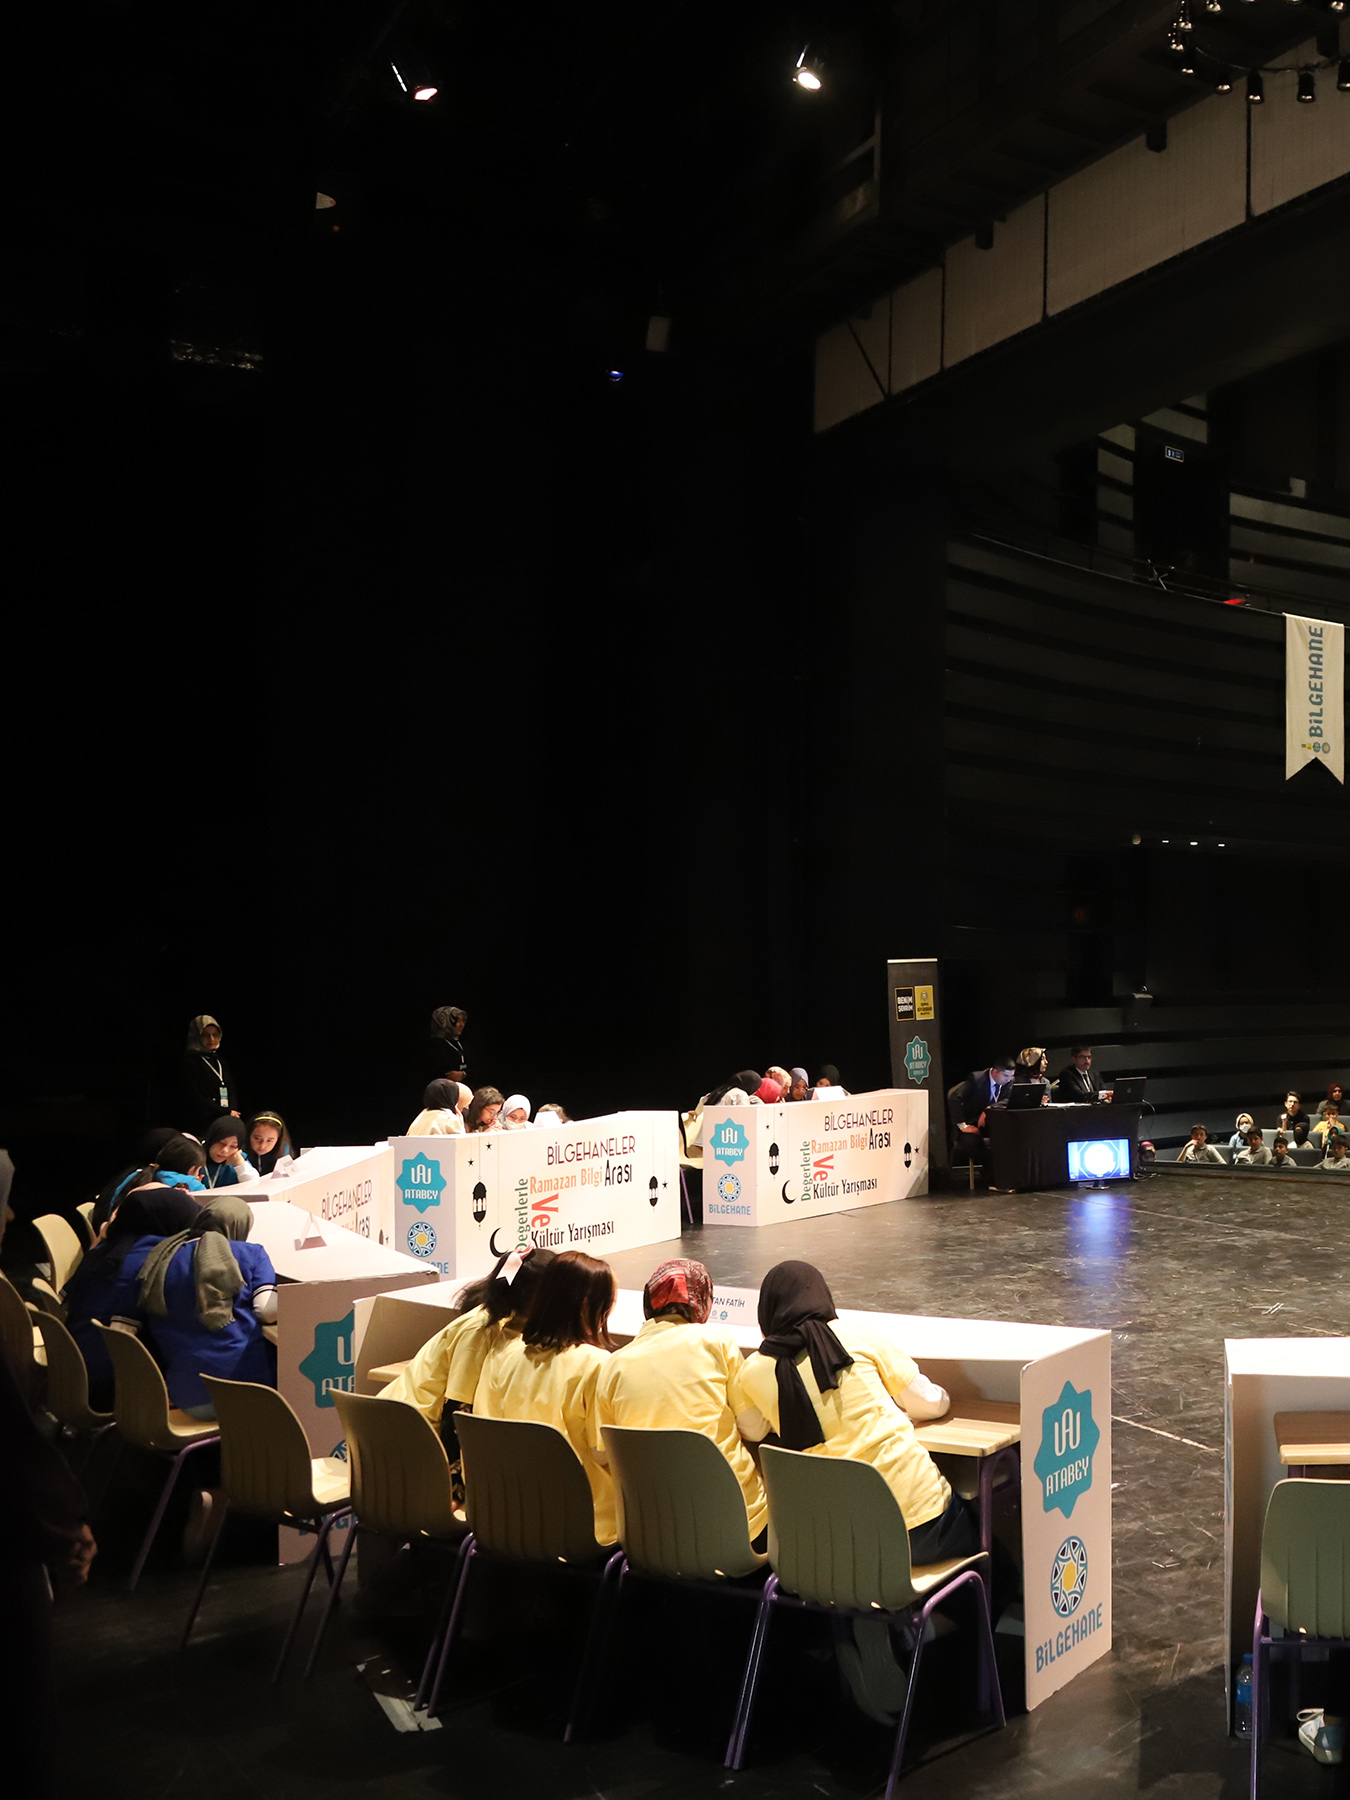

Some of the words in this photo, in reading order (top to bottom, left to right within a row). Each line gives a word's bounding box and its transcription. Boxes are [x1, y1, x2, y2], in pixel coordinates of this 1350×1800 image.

[547, 1135, 636, 1166] BİLGEHANELER
[716, 1147, 743, 1156] ATABEY
[811, 1139, 848, 1154] Ramazan
[850, 1133, 868, 1151] Bilgi
[868, 1128, 891, 1150] Arası
[530, 1176, 577, 1194] Ramazan
[580, 1166, 603, 1187] Bilgi
[604, 1159, 633, 1186] Arası
[813, 1154, 834, 1182] Ve
[404, 1188, 439, 1200] ATABEY
[813, 1182, 839, 1200] Kültür
[841, 1178, 878, 1196] Yarışması
[531, 1193, 559, 1228] Ve
[531, 1228, 565, 1249] Kültür
[567, 1220, 615, 1243] Yarışması
[1045, 1456, 1090, 1497] ATABEY
